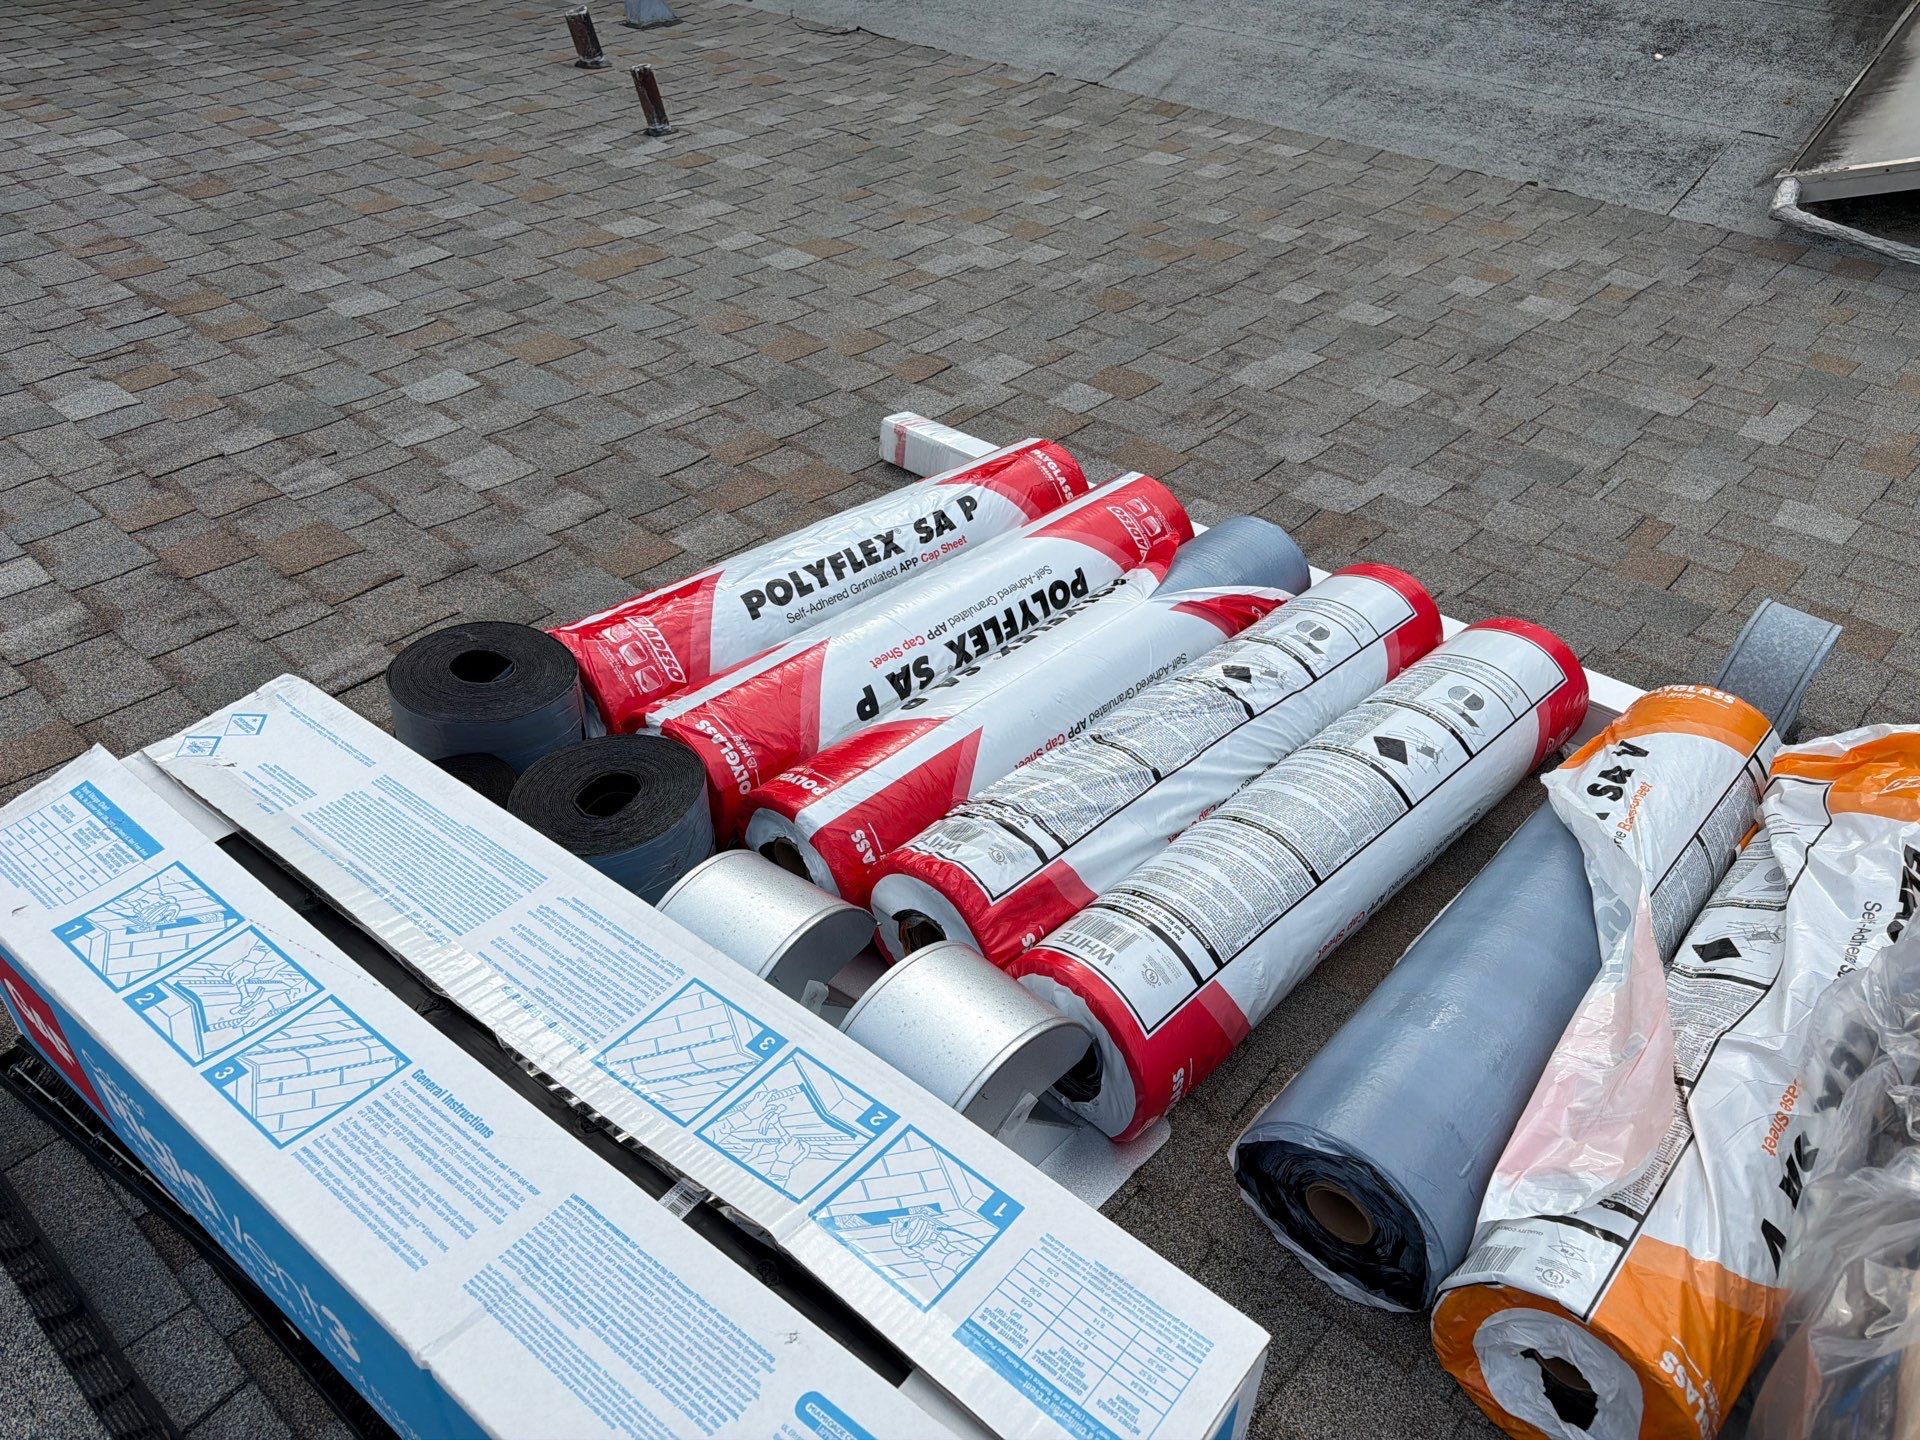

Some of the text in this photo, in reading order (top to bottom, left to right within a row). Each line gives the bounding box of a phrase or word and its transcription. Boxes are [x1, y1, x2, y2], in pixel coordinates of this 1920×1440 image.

[913, 509, 957, 544] SA
[957, 495, 978, 522] P
[786, 534, 968, 624] Self-Adhered Granulated APP Cap Sheet
[869, 564, 1053, 669] Self-Adhered Granulated APP Cap Sheet
[884, 655, 935, 701] SA
[856, 684, 880, 722] P
[1088, 686, 1135, 723] Granulated
[1045, 732, 1067, 752] Cap
[1067, 717, 1088, 740] APP
[694, 719, 752, 795] OLYGLASS
[1054, 931, 1116, 967] WHITE
[134, 992, 156, 1006] 2
[3, 977, 77, 1068] GAF
[757, 1035, 777, 1050] 3
[213, 1065, 234, 1080] 3
[409, 1068, 497, 1139] General Instructions
[868, 1111, 887, 1127] 2
[1760, 1110, 1790, 1158] Sheet
